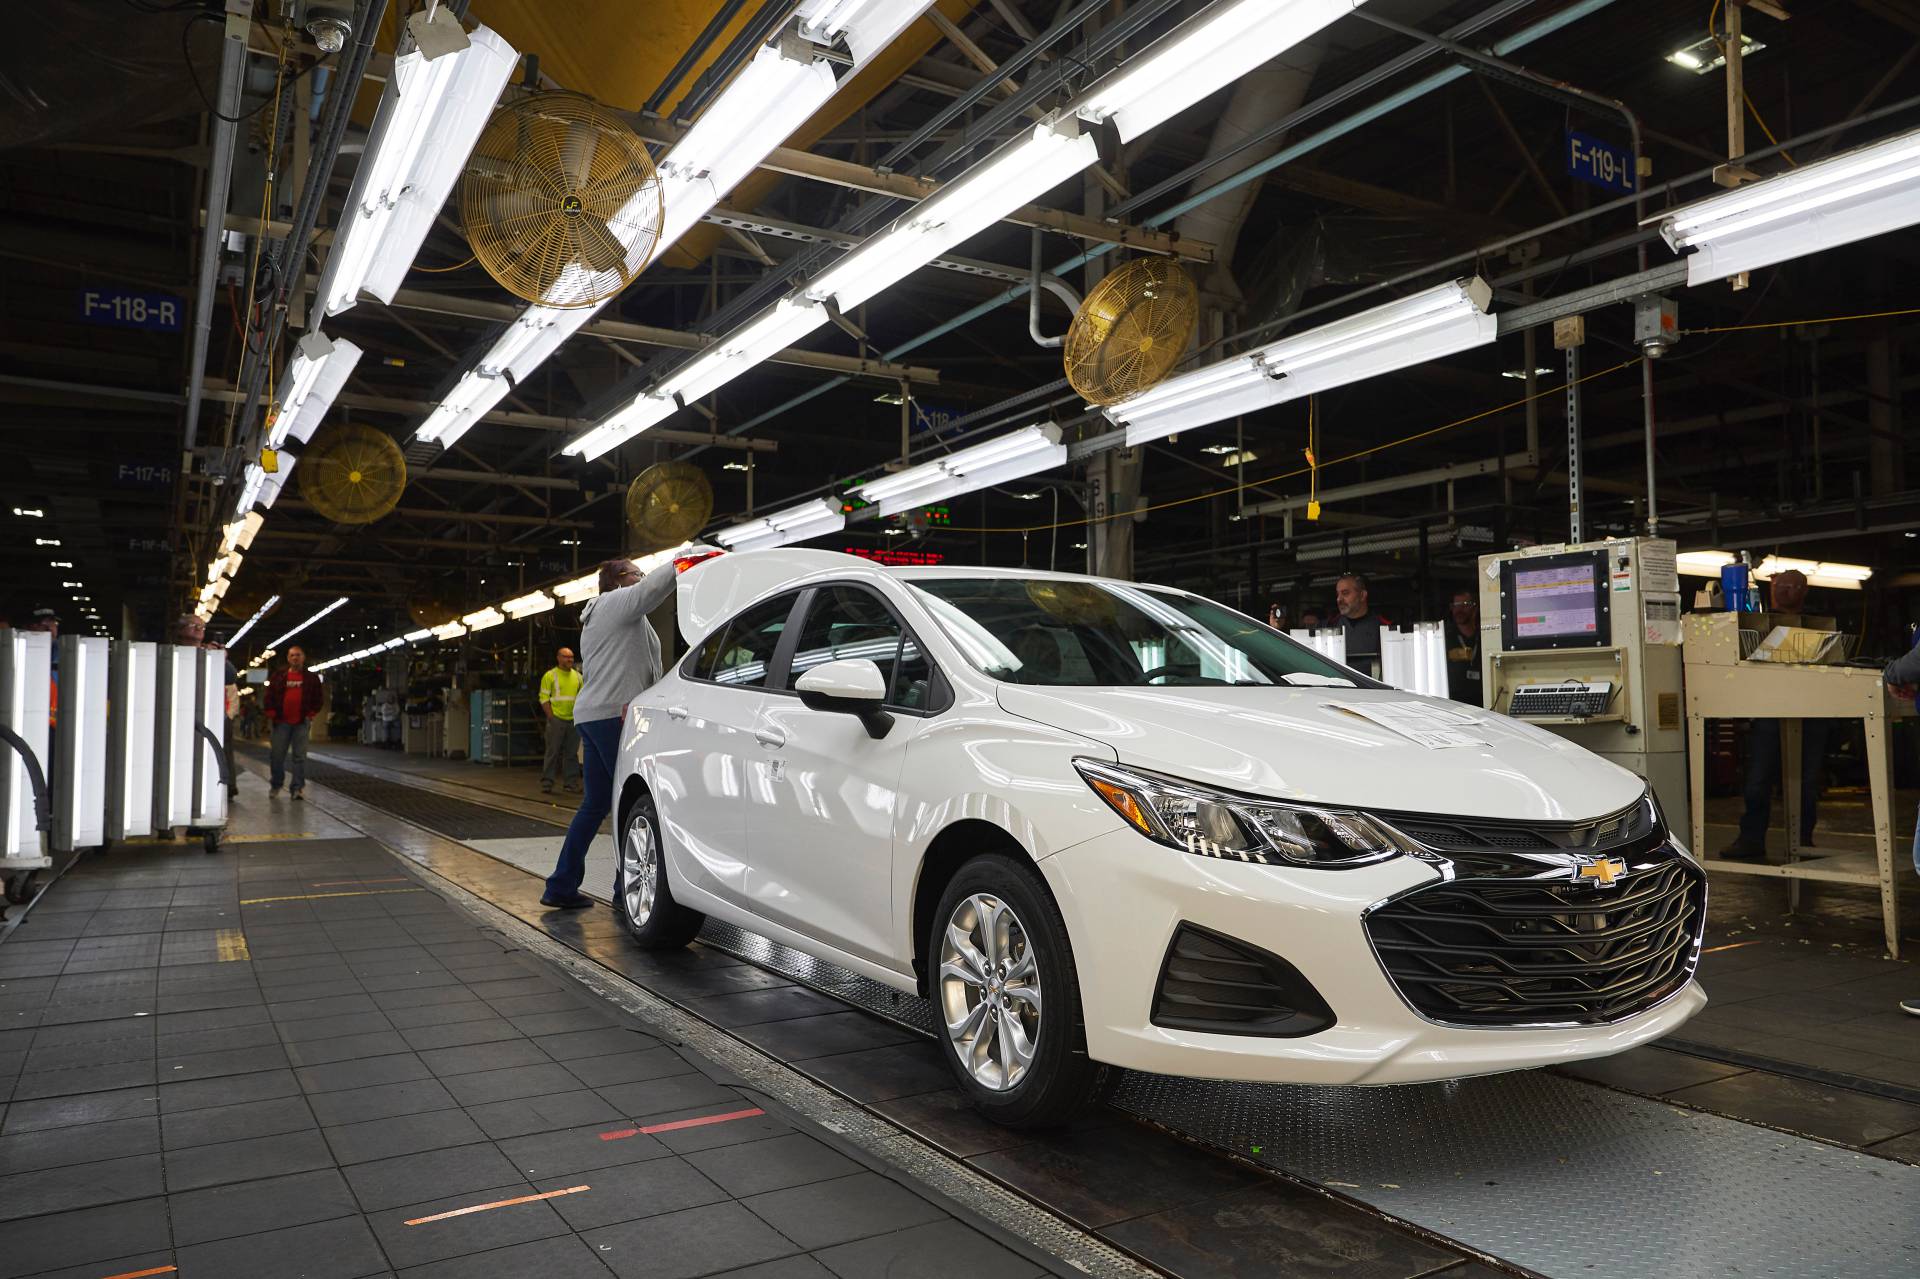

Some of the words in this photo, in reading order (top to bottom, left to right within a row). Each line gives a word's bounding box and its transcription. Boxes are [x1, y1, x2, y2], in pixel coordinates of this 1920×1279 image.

[1571, 138, 1633, 189] F-119-L
[84, 292, 176, 326] F-118-R
[118, 465, 171, 483] F-117-R
